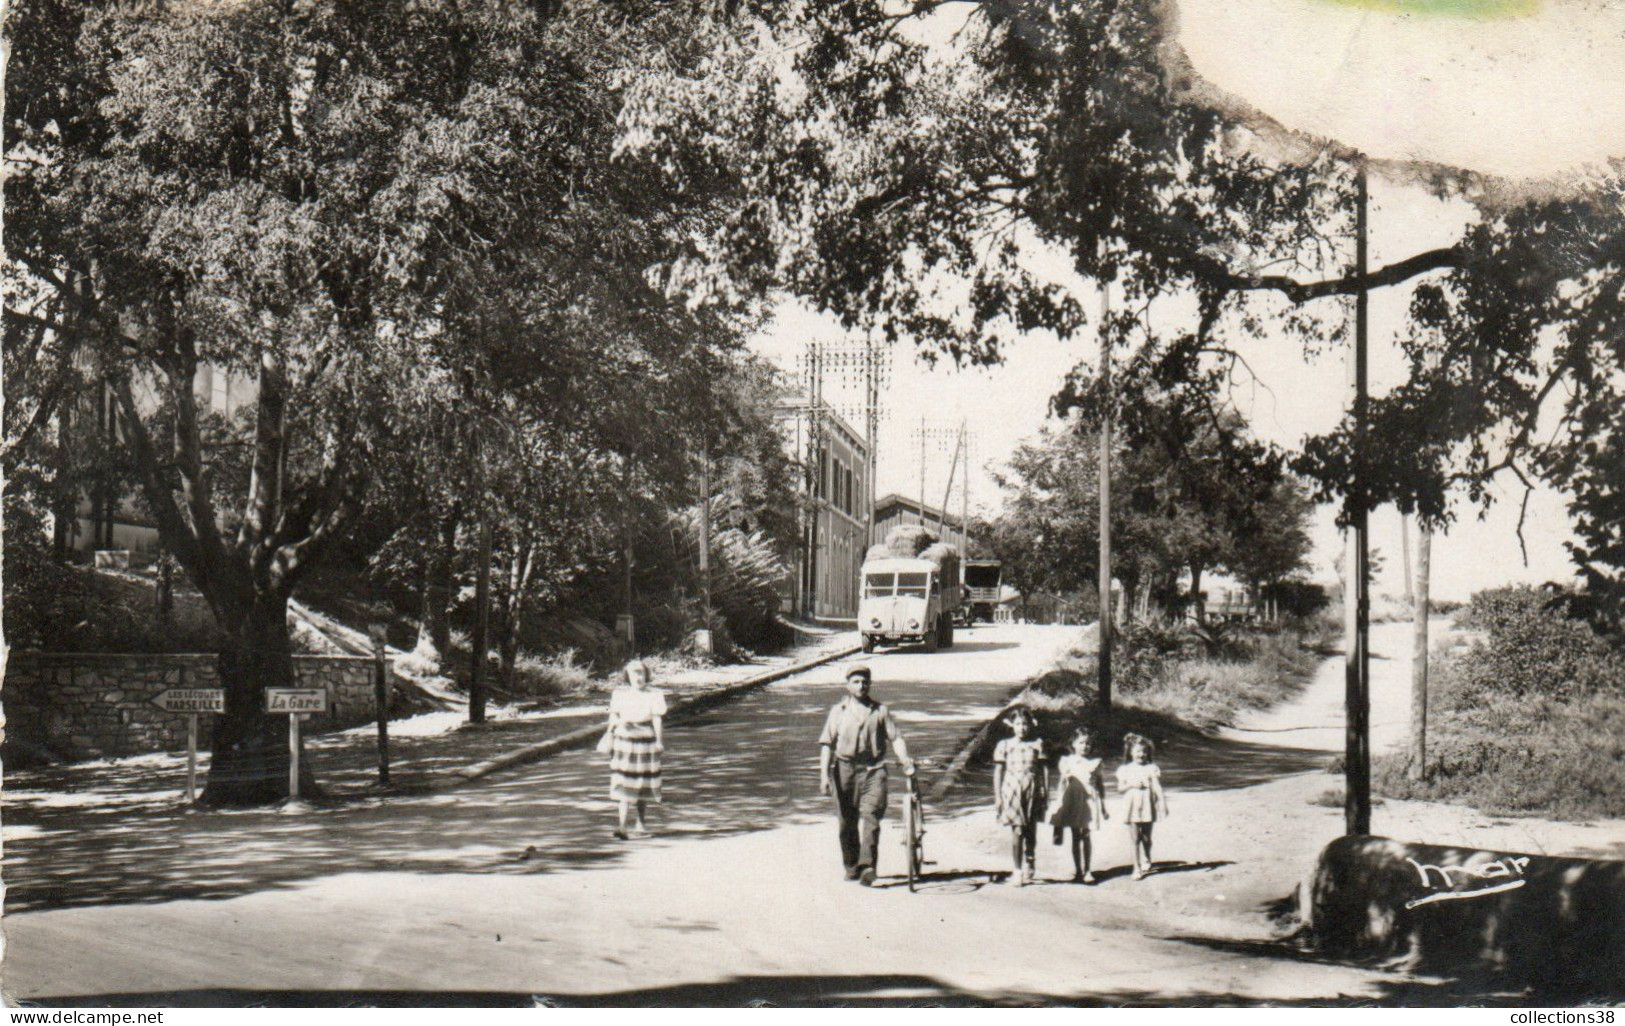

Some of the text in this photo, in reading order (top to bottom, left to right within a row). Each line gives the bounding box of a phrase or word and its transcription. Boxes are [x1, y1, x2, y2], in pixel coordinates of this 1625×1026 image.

[168, 691, 183, 699] LES
[166, 700, 221, 710] MARSEILLE
[271, 695, 320, 709] La Gare
